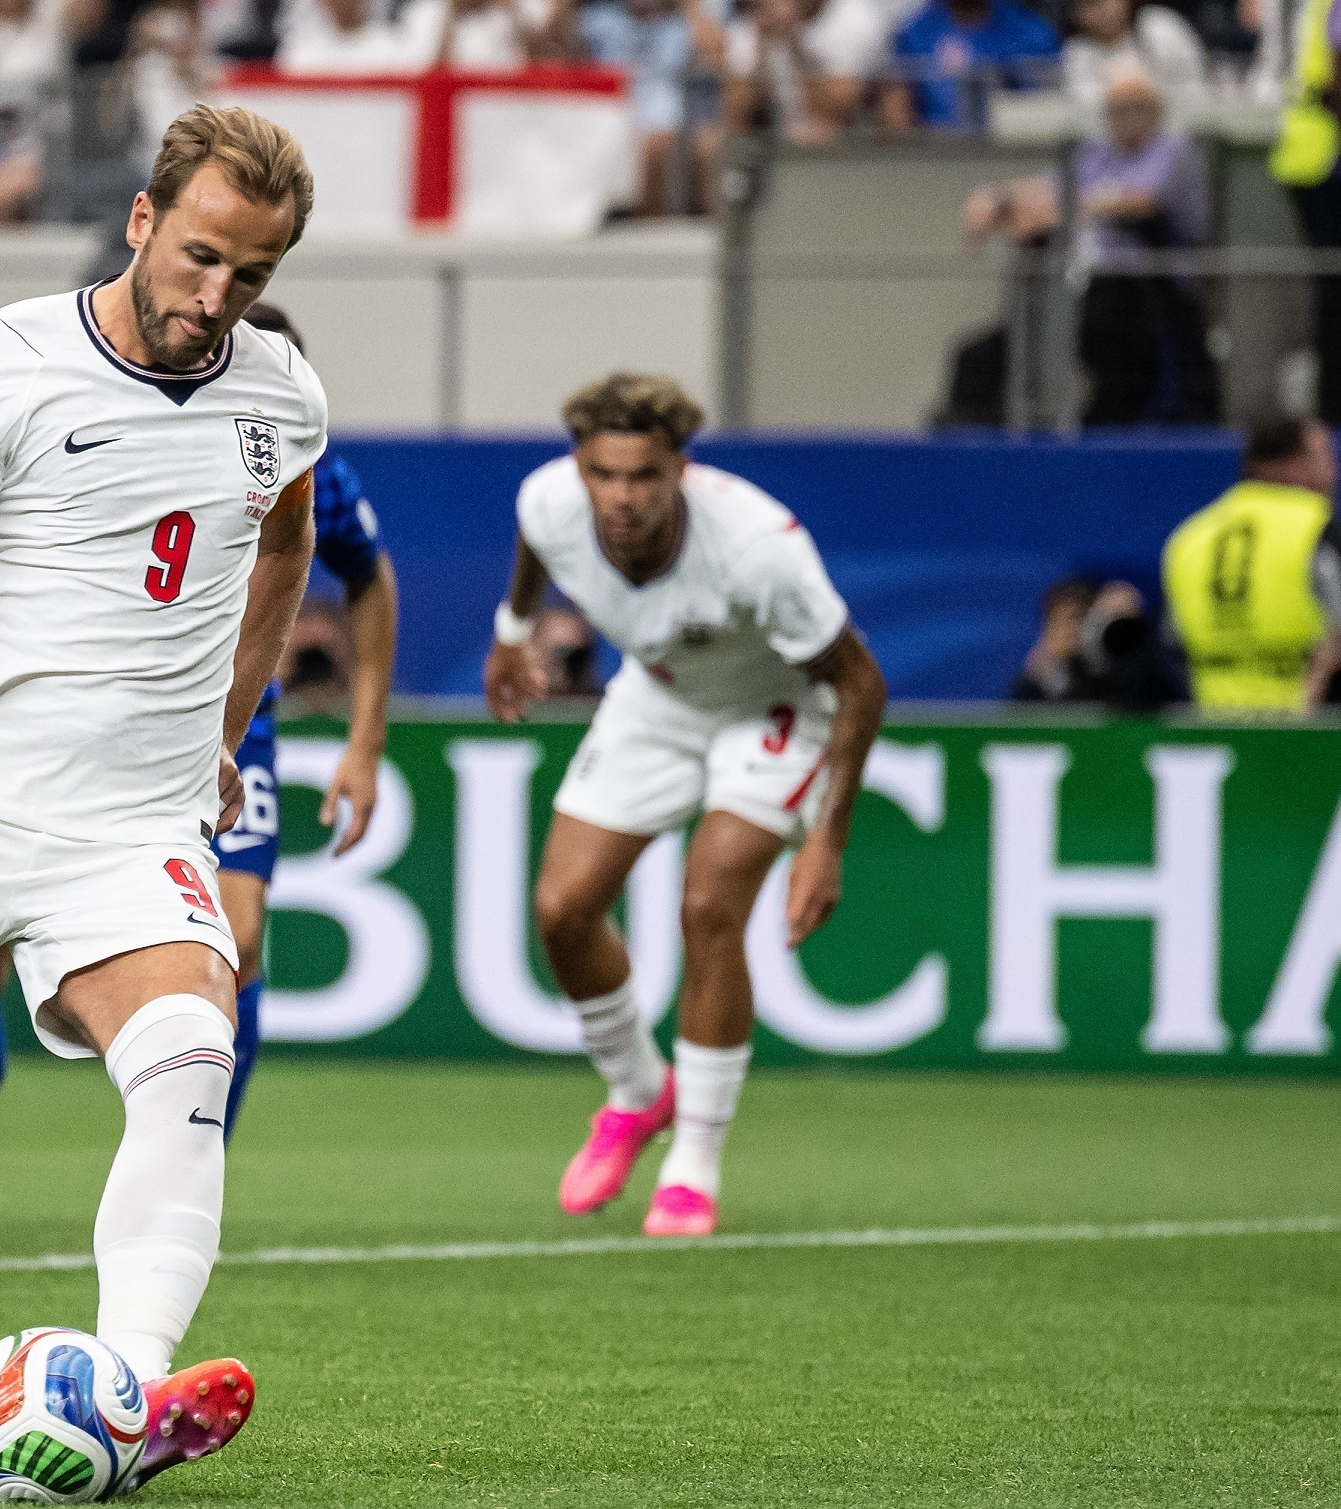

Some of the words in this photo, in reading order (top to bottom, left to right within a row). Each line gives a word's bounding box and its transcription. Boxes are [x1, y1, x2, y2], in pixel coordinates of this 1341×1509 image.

[144, 511, 196, 604] 9
[761, 702, 797, 757] 3
[163, 858, 218, 918] 9
